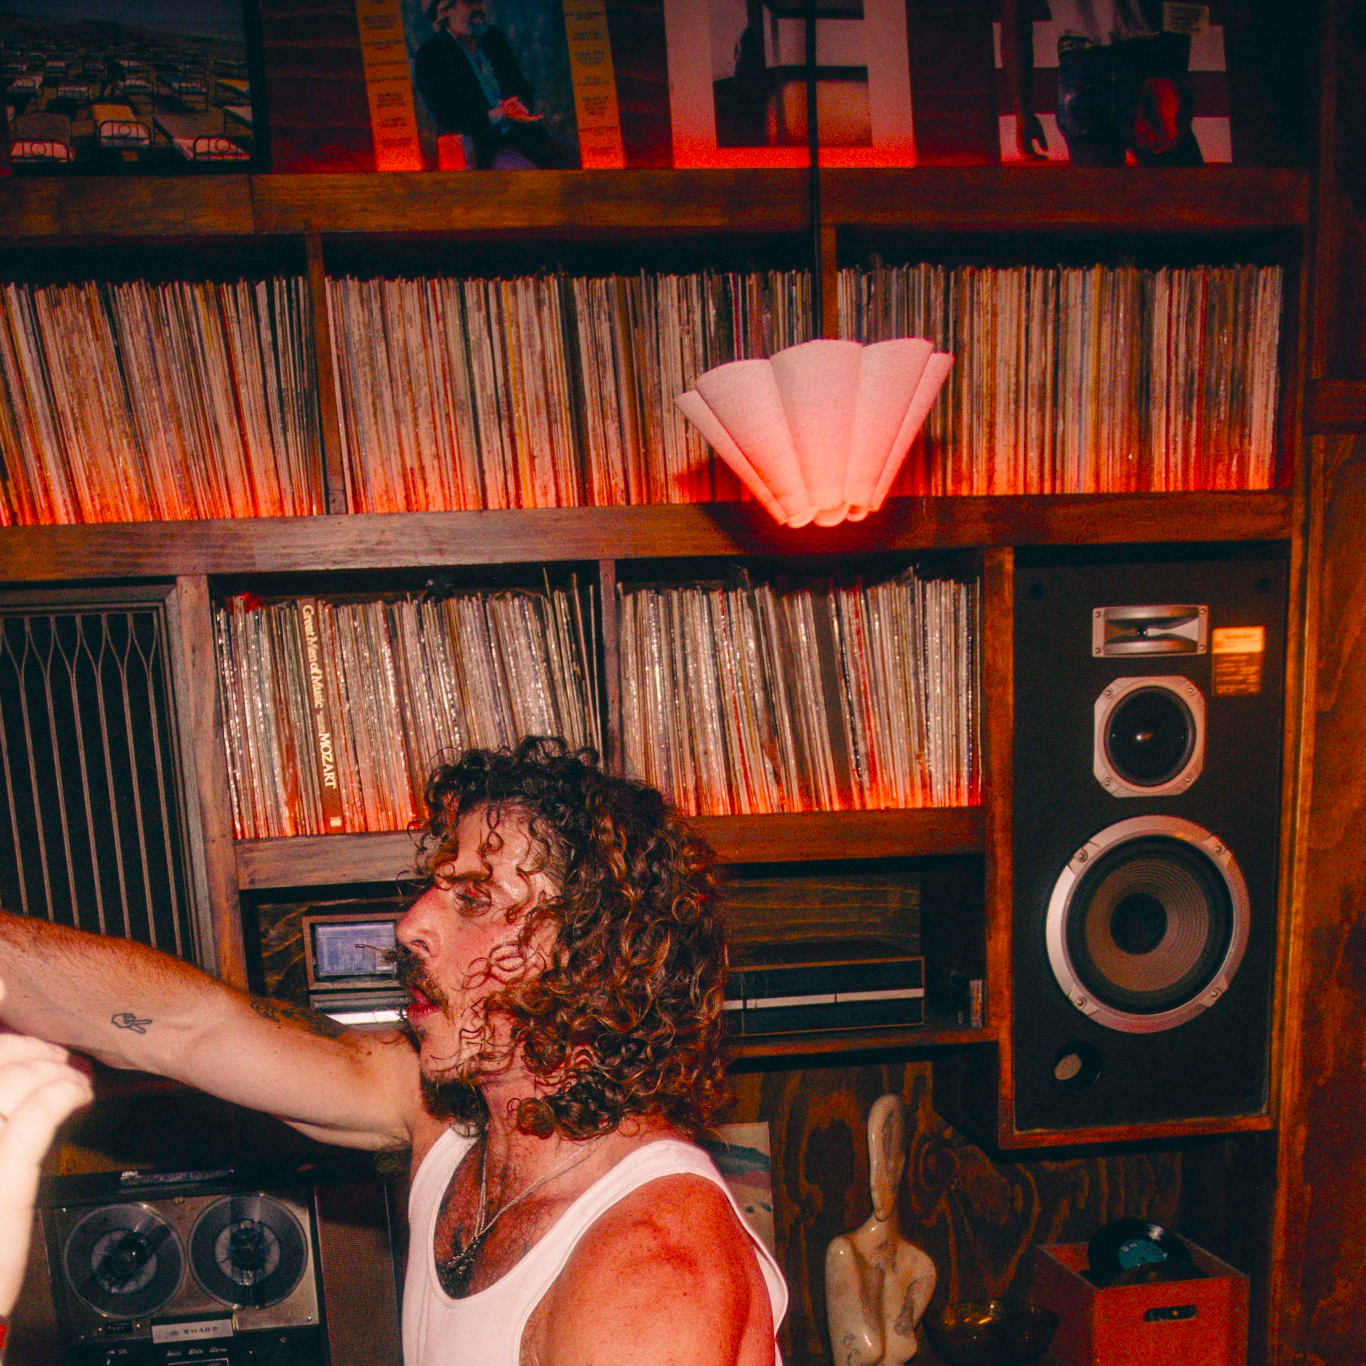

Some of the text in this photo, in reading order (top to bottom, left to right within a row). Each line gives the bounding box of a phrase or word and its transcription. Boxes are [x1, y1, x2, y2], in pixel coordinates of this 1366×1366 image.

[310, 674, 325, 708] Music
[317, 732, 336, 789] MOZART
[183, 1326, 218, 1335] SHARP
